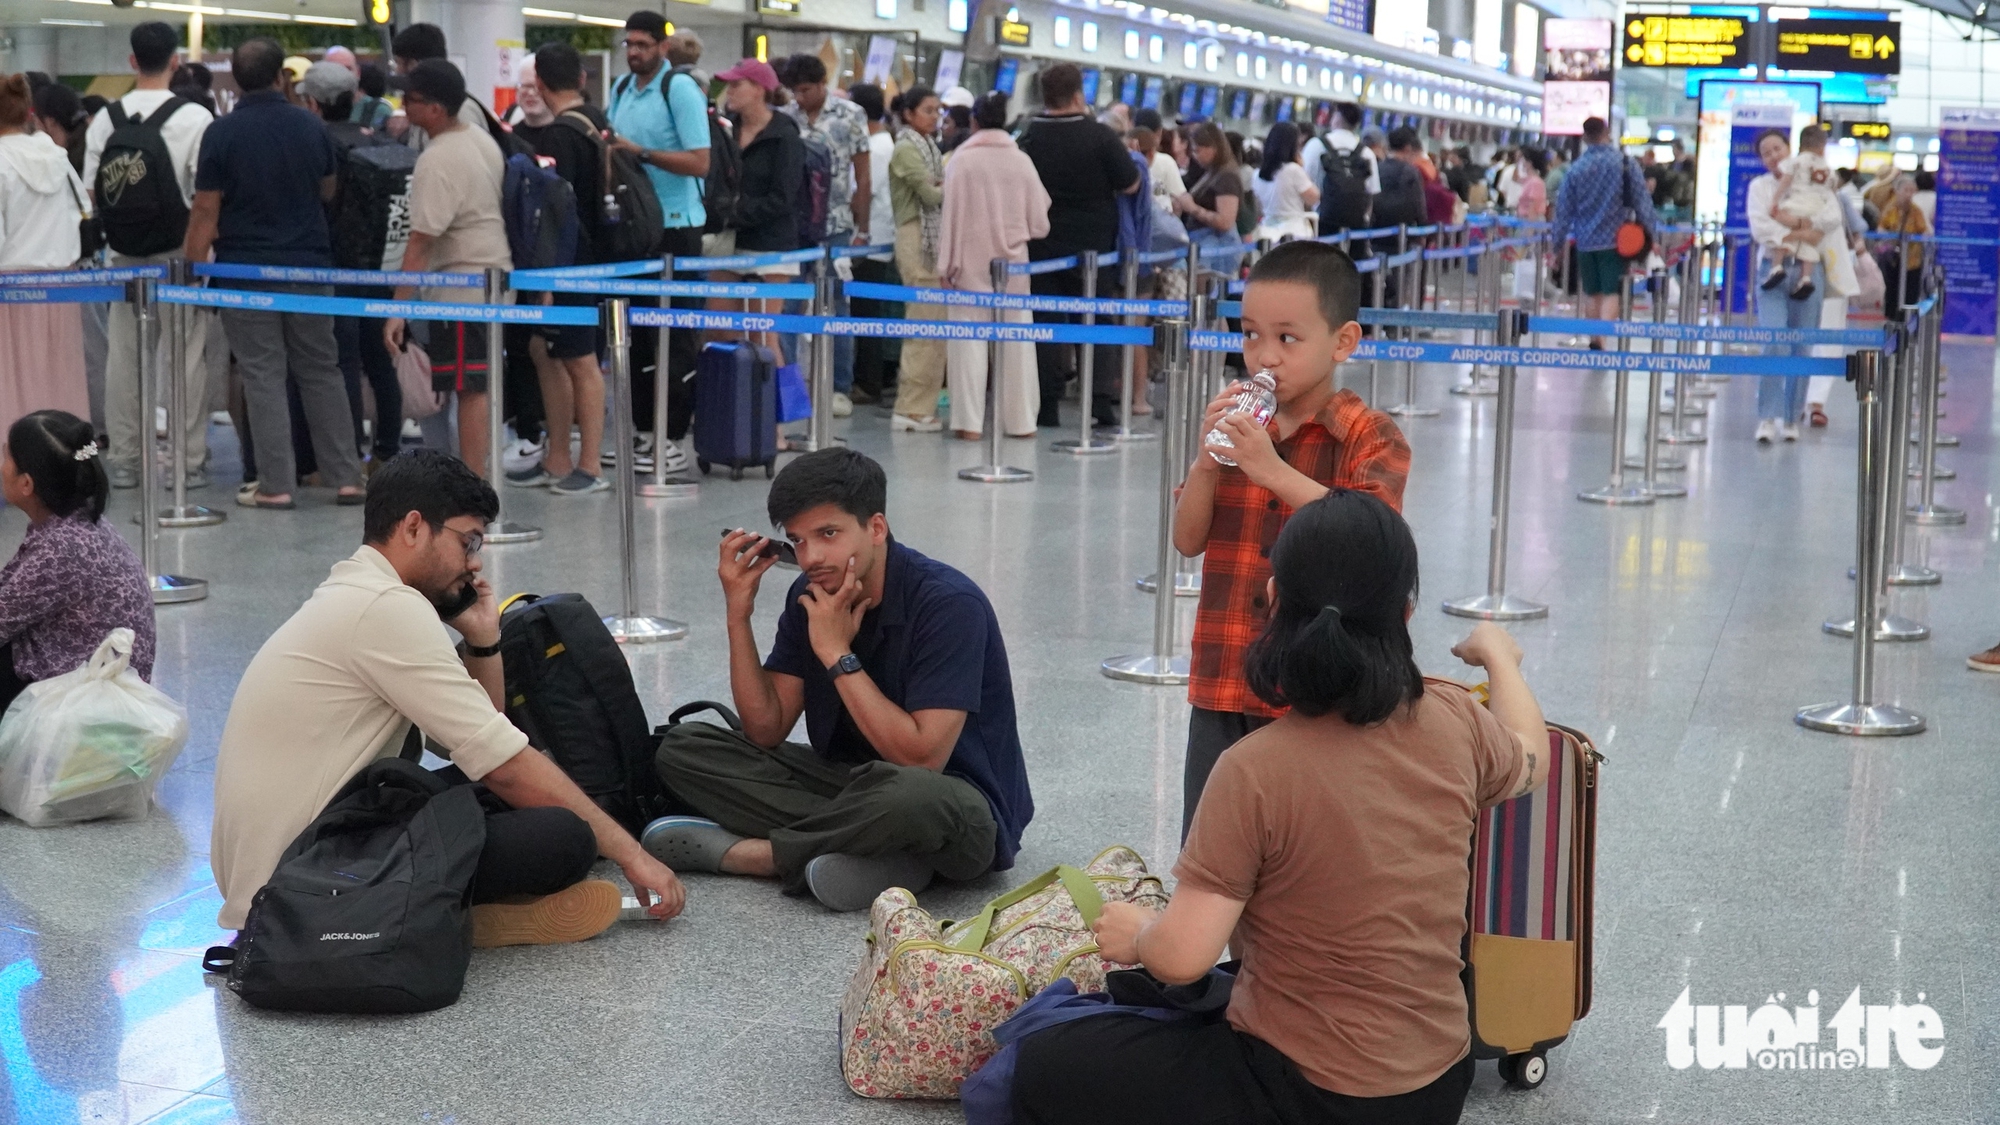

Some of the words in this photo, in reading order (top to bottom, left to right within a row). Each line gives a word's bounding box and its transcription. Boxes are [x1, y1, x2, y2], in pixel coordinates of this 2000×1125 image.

[386, 194, 406, 242] FACE
[113, 270, 133, 280] NAM
[445, 276, 468, 286] NAM
[3, 290, 47, 300] VIETNAM
[710, 286, 729, 294] NAM
[734, 286, 758, 294] CTCP
[222, 294, 242, 304] NAM
[249, 296, 274, 306] CTCP
[946, 291, 976, 304] CÔNG
[979, 294, 992, 305] TY
[1026, 298, 1056, 310] HÀNG
[1058, 300, 1096, 312] KHÔNG
[1098, 300, 1122, 315] VIỆT
[1124, 302, 1150, 314] NAM
[1158, 302, 1188, 314] CTCP
[364, 302, 412, 315] AIRPORTS
[414, 304, 482, 317] CORPORATION
[484, 307, 498, 318] OF
[501, 308, 543, 320] VIETNAM
[632, 310, 674, 325] KHÔNG
[676, 312, 702, 328] VIỆT
[704, 316, 732, 328] NAM
[742, 317, 775, 330] CTCP
[824, 321, 884, 334] AIRPORTS
[886, 323, 974, 337] CORPORATION
[976, 326, 993, 338] OF
[996, 327, 1054, 340] VIETNAM
[1685, 328, 1700, 338] TY
[1190, 333, 1218, 348] ẢNG
[1388, 346, 1425, 358] CTCP
[1452, 348, 1520, 362] AIRPORTS
[1522, 351, 1622, 367] CORPORATION
[1625, 355, 1643, 368] OF
[1646, 356, 1711, 370] VIETNAM
[320, 932, 380, 941] JACK&JONES
